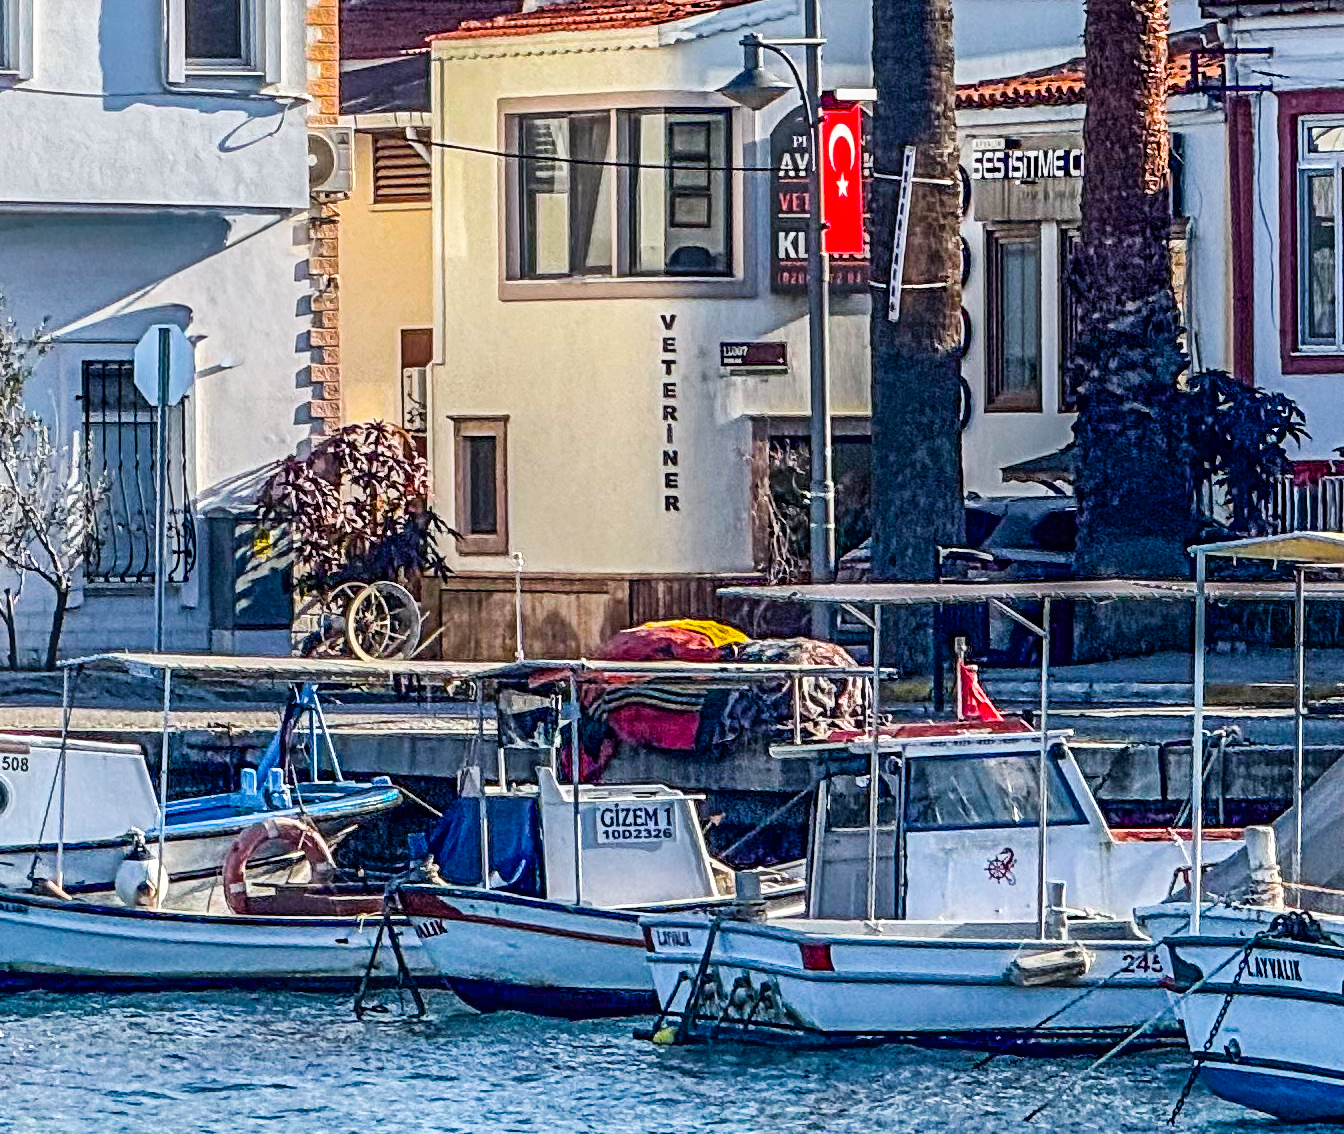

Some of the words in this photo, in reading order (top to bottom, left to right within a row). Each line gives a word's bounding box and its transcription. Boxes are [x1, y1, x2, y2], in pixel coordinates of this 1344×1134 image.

[972, 150, 1004, 179] SES
[660, 314, 680, 512] VETERİNER
[600, 803, 660, 827] GİZEM
[664, 807, 672, 827] 1
